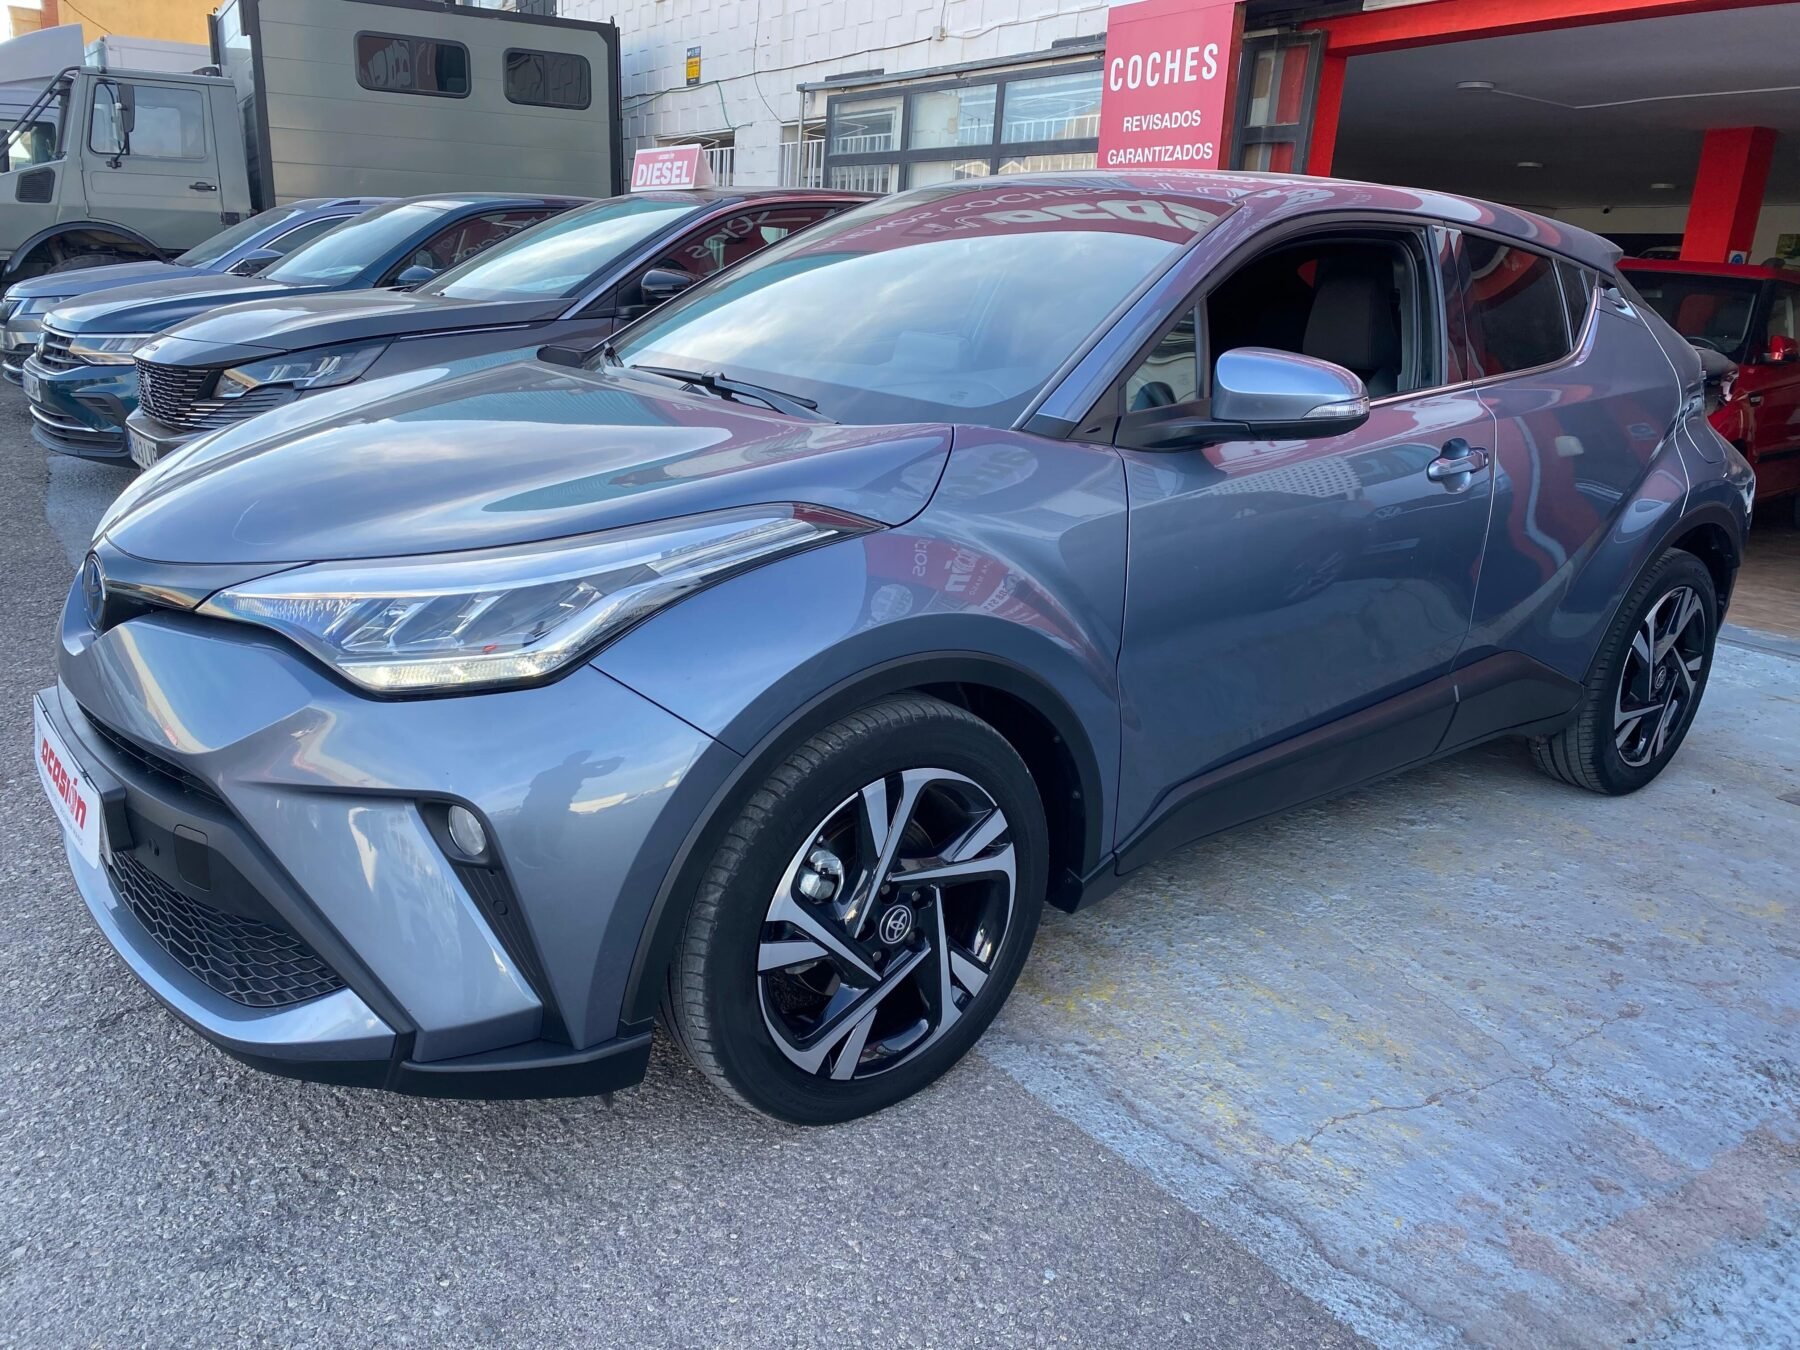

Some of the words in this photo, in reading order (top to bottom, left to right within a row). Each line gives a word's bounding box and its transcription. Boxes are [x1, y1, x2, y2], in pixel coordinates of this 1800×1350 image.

[1109, 43, 1219, 92] COCHES
[1122, 109, 1202, 133] REVISADOS
[1107, 142, 1213, 165] GARANTIZADOS
[636, 160, 690, 186] DIESEL
